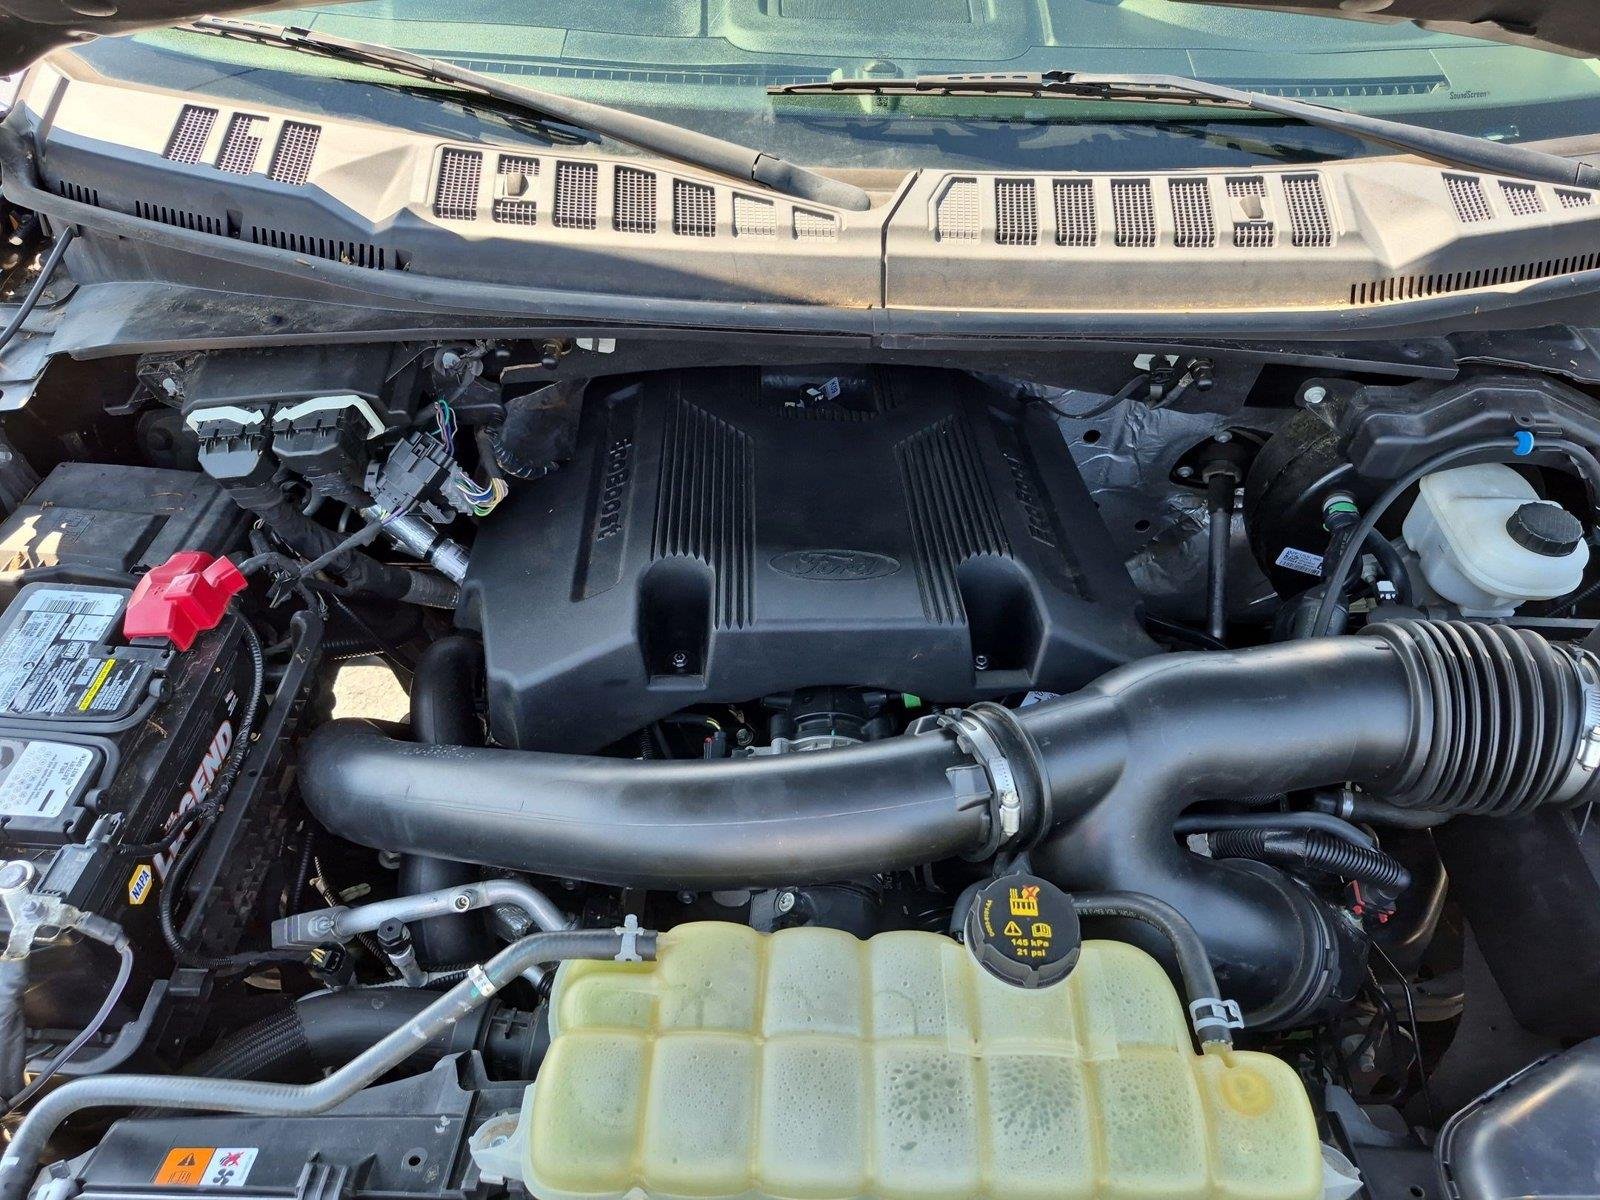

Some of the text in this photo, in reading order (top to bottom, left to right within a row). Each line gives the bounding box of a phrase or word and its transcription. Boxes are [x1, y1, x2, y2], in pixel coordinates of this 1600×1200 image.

[787, 551, 884, 578] Ford
[131, 869, 150, 900] NAPA
[1011, 938, 1050, 948] 145 kPa
[1016, 947, 1046, 958] 21 psi
